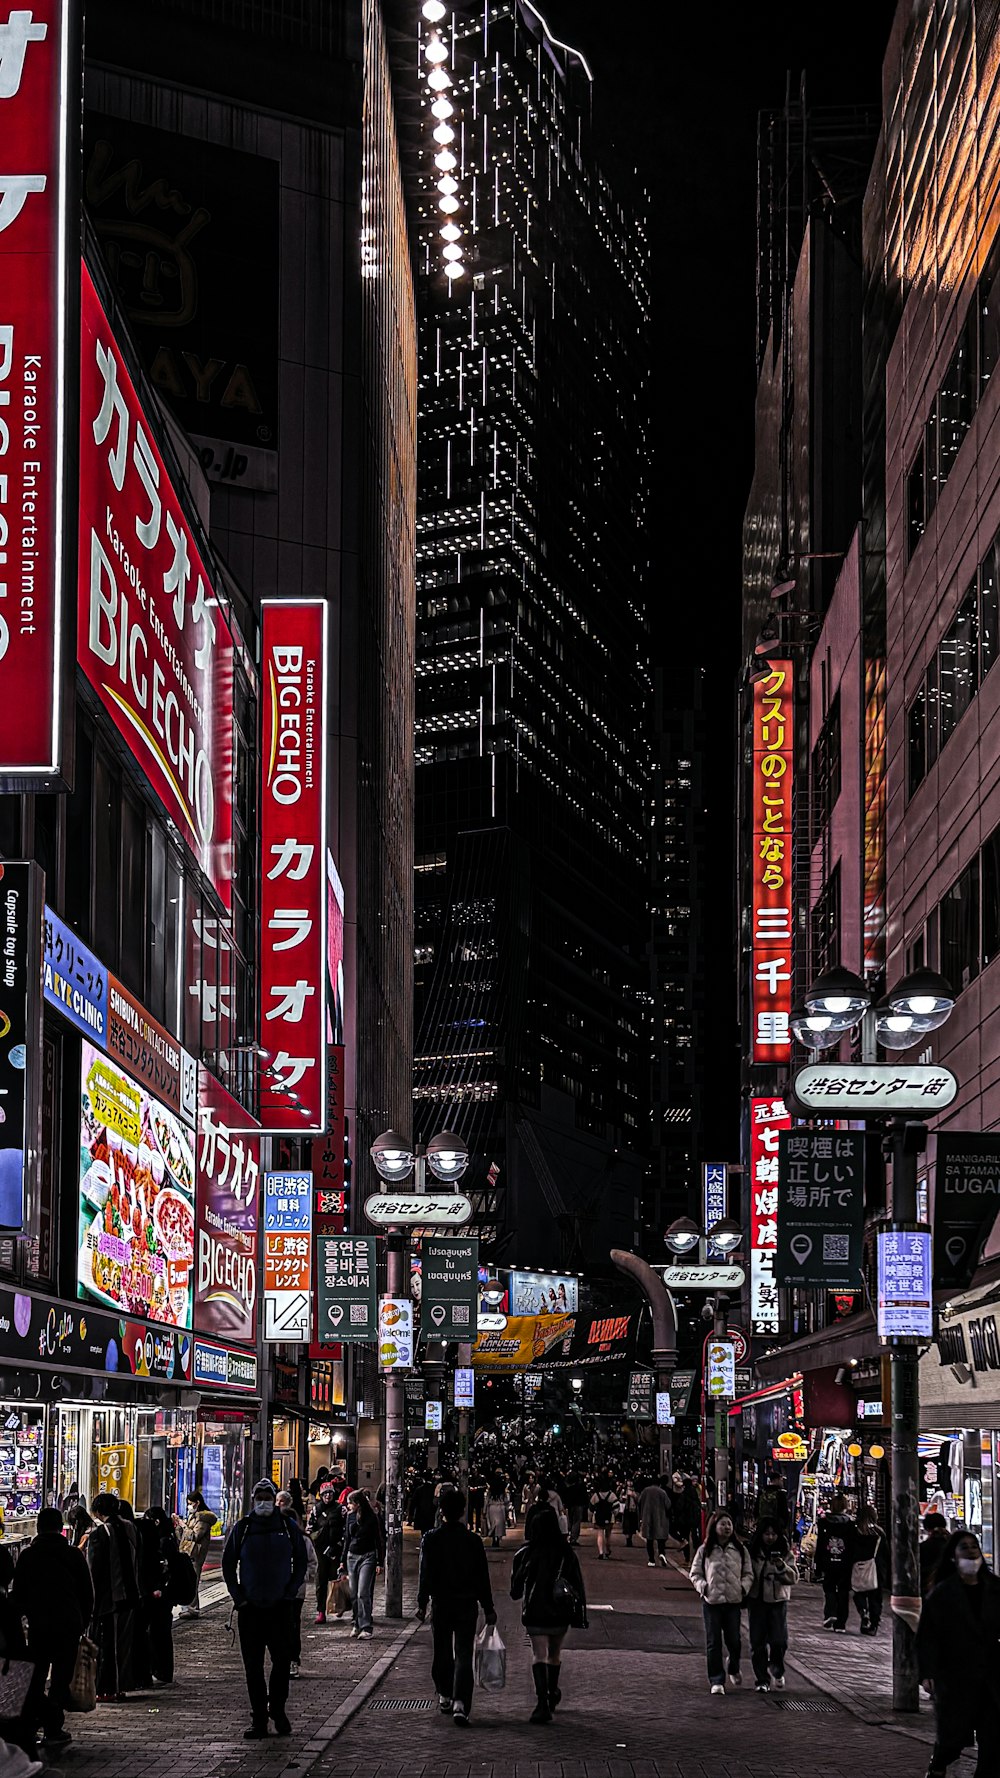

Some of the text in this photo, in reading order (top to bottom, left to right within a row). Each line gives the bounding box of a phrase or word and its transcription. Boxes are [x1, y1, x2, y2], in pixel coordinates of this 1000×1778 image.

[20, 355, 42, 635] Karaoke Entertainment
[93, 338, 216, 670] カラオケ
[106, 505, 147, 609] Karaoke
[89, 527, 214, 845] BIG ECHO
[272, 646, 303, 805] BIG ECHO
[304, 659, 315, 789] Karaoke Entertainment
[758, 669, 788, 891] クスリのことなら
[4, 889, 19, 987] Capsule toy shop
[265, 838, 316, 1094] カラオケ
[755, 908, 792, 1044] 三千里
[72, 990, 104, 1035] CLINIC
[109, 987, 180, 1072] SHIBUYA CONTACT LENS
[110, 1015, 179, 1100] 渋谷コンタクトレンズ
[803, 1077, 949, 1097] 渋谷センター街
[199, 1107, 259, 1207] カラオケ
[786, 1136, 855, 1160] 喫煙は
[786, 1161, 855, 1185] 正しい
[945, 1165, 961, 1176] SA
[284, 1176, 310, 1197] 渋谷
[944, 1178, 1000, 1194] LUGA
[277, 1198, 300, 1213] 眼科
[786, 1187, 854, 1208] 場所で
[370, 1202, 466, 1216] 渋谷センター街
[266, 1214, 310, 1228] クリニック
[284, 1236, 309, 1257] 渋谷
[324, 1240, 370, 1258] 흡연은
[198, 1228, 224, 1293] BIG
[225, 1247, 256, 1312] ECHO
[266, 1258, 310, 1273] コンタクト
[324, 1257, 370, 1274] 올바른
[667, 1270, 739, 1282] 渋谷センター街
[275, 1273, 301, 1287] レンズ
[324, 1275, 370, 1289] 장소에서
[292, 1317, 308, 1328] 入口
[380, 1327, 411, 1338] Welcome
[683, 1436, 698, 1447] dip
